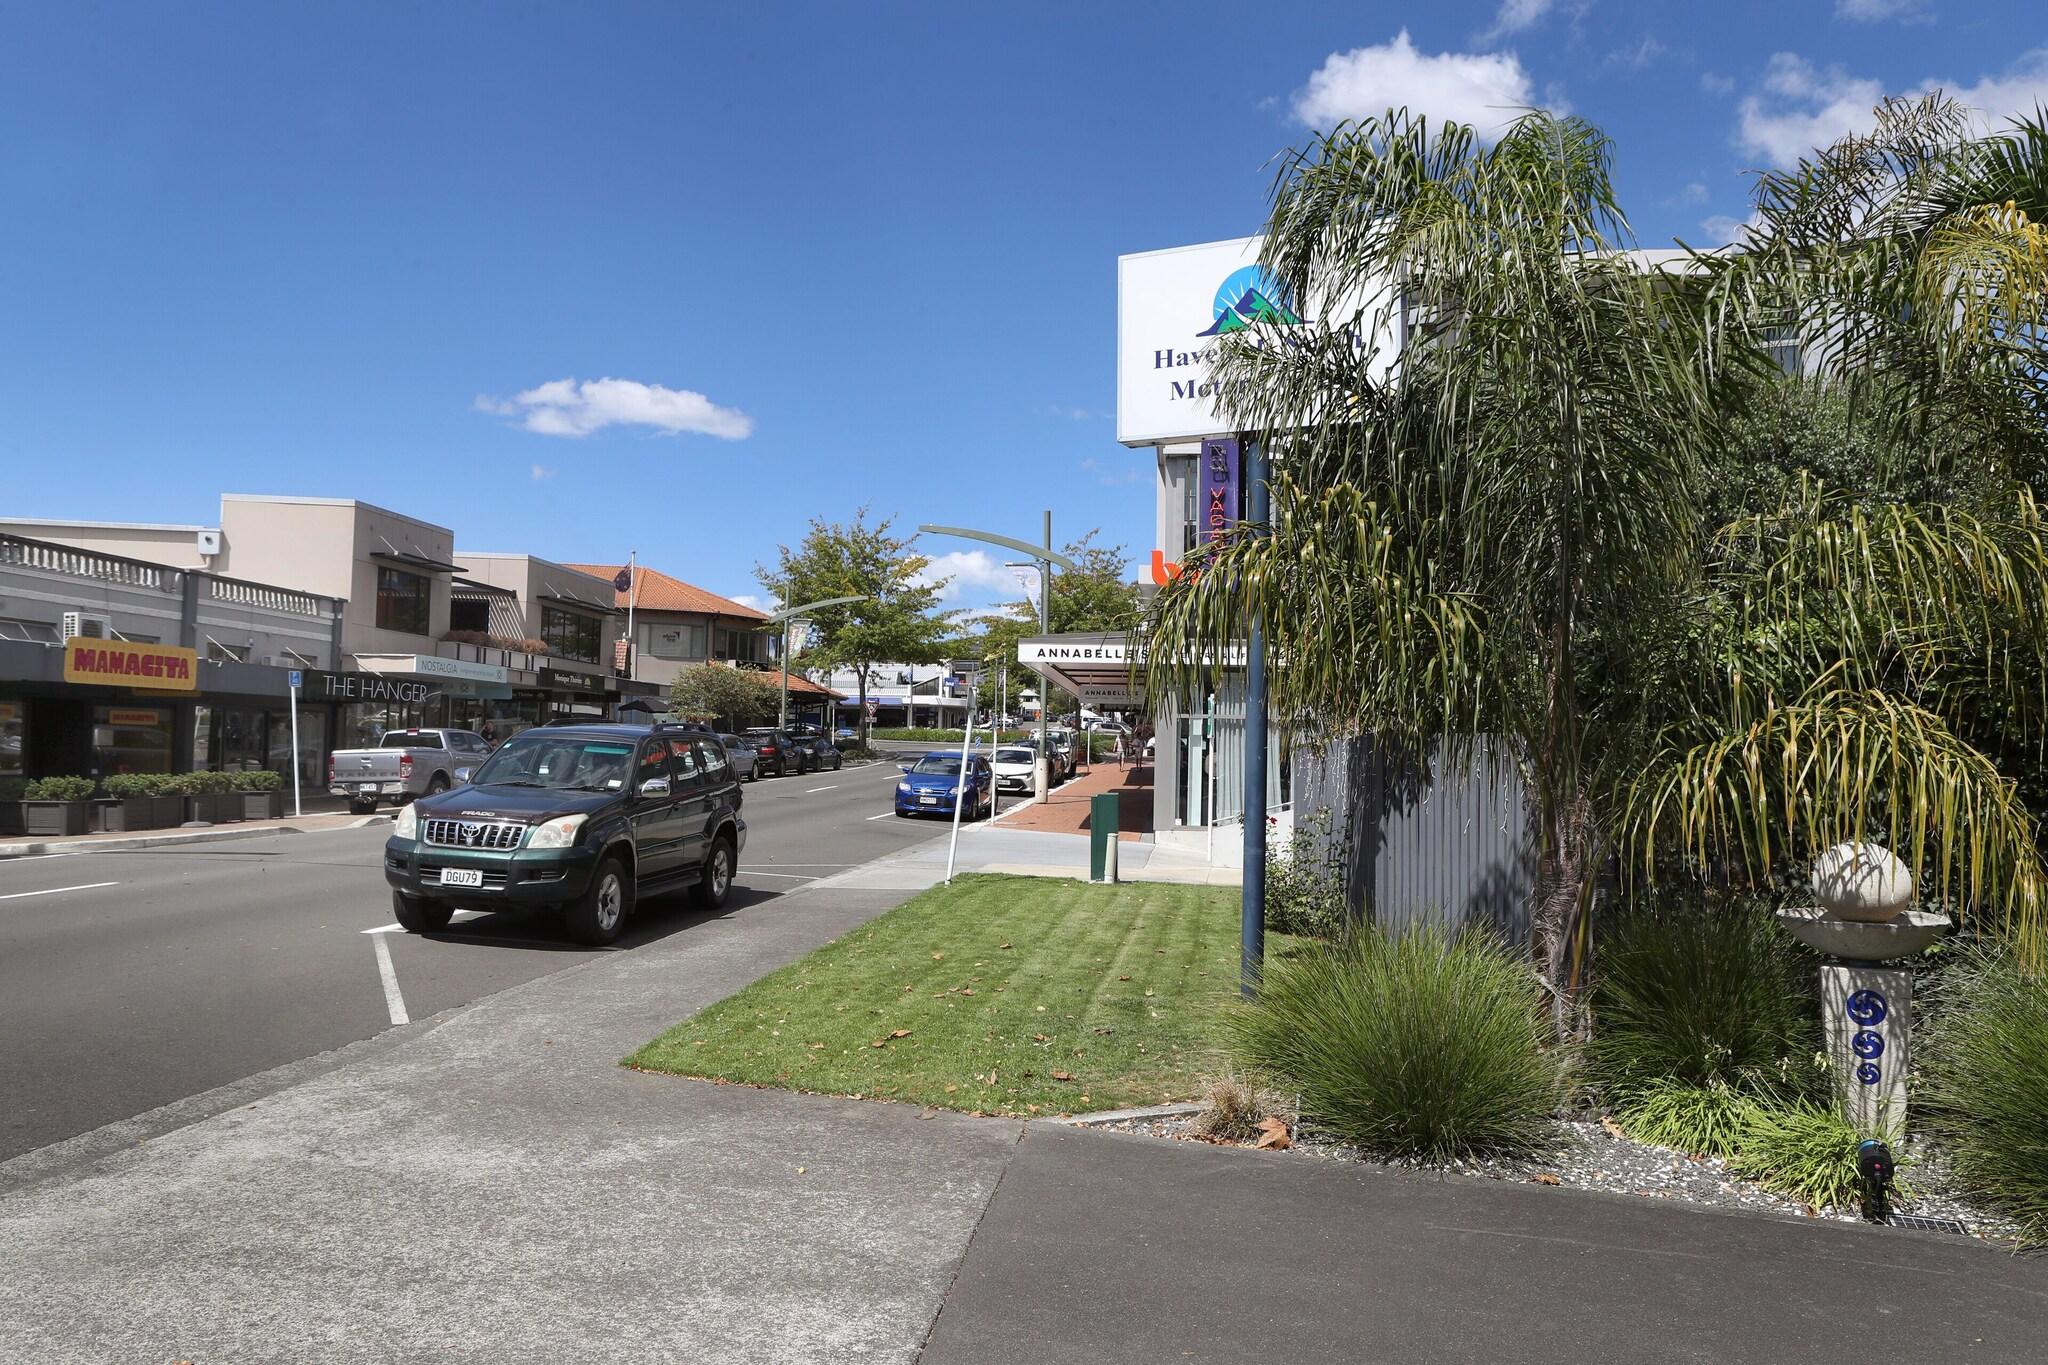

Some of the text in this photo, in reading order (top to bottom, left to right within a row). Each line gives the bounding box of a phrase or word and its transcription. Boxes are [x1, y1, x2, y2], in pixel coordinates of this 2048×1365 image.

[73, 647, 189, 679] MAMACITA
[421, 660, 458, 674] NOSTALGIA
[323, 675, 427, 702] THE HANGER
[445, 871, 478, 884] DGU79
